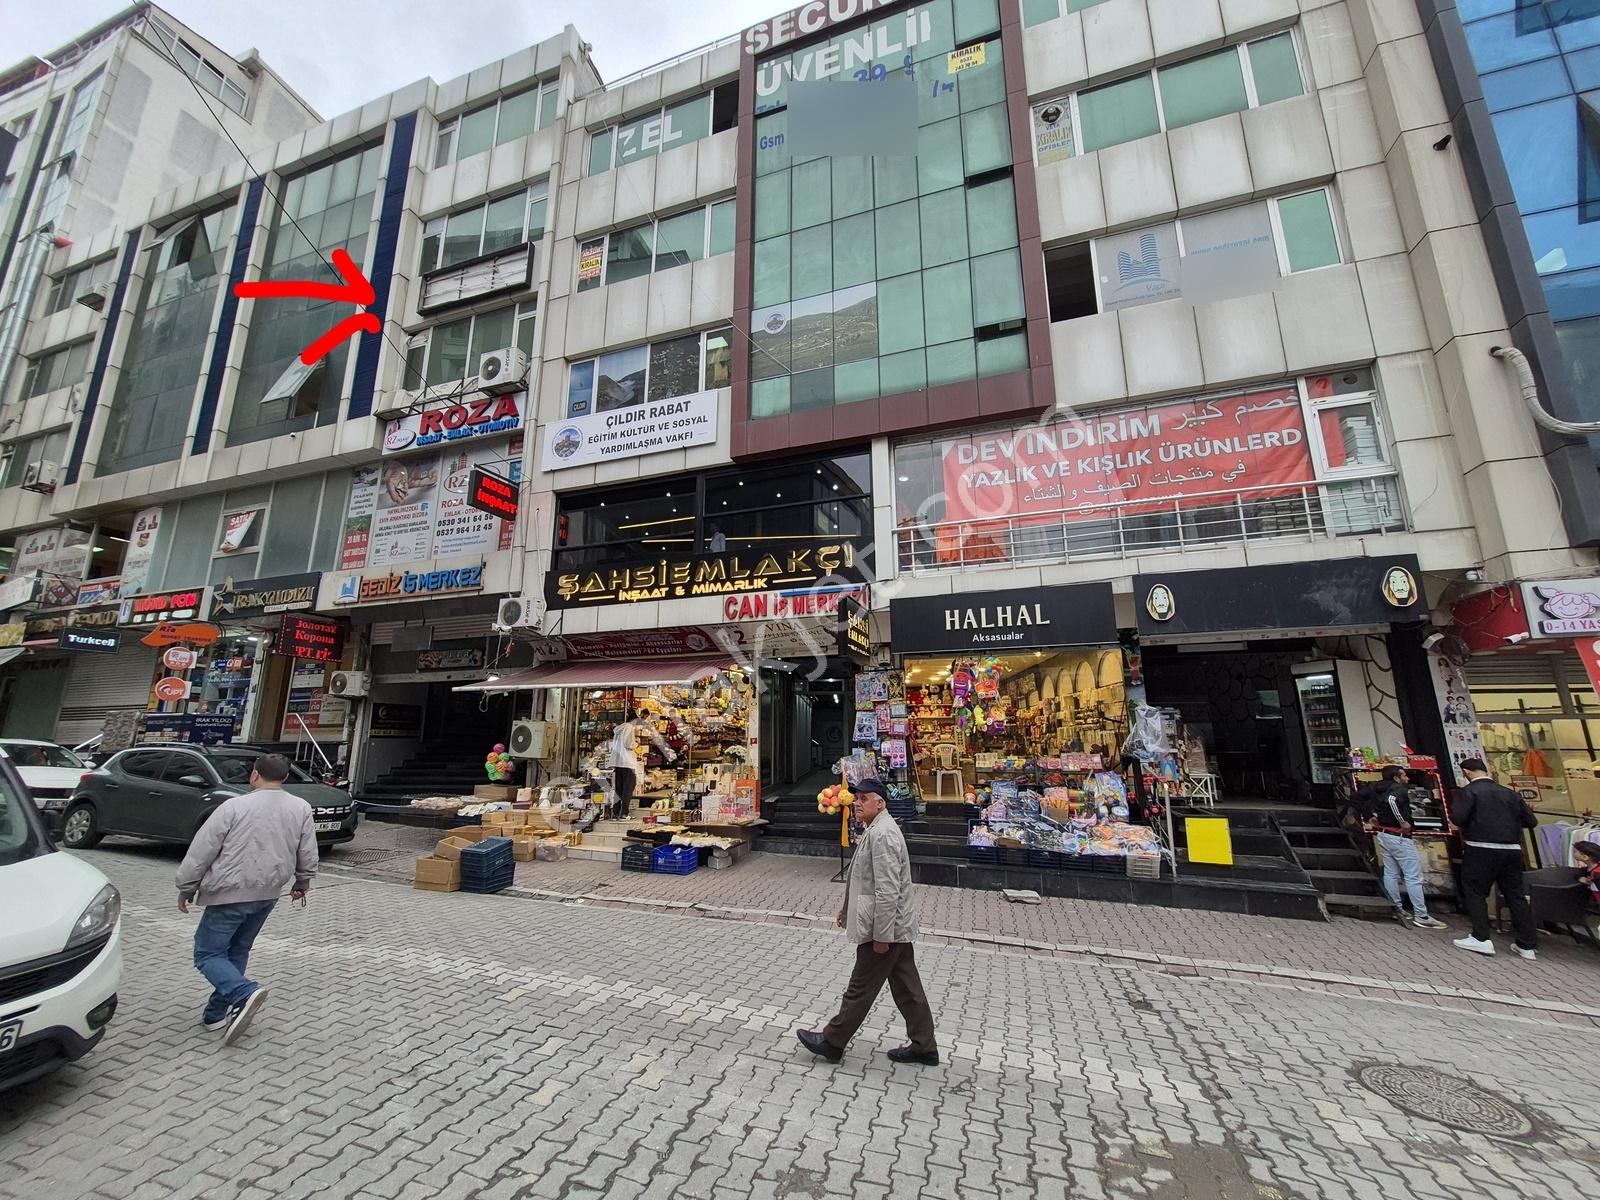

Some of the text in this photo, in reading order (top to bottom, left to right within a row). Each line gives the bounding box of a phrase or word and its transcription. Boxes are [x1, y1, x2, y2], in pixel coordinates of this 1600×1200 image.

[760, 133, 785, 150] Gsm
[419, 393, 520, 436] ROZA
[606, 401, 692, 428] ÇILDIR RABAT
[1171, 400, 1223, 430] كبير
[588, 415, 709, 444] EĞİTİM KÜLTÜR VE SOSYAL
[956, 413, 1160, 465] DEV İNDİRİM
[600, 431, 693, 455] YARDIMLAŞMA VAKFI
[962, 464, 1036, 489] YAZLIK
[1041, 461, 1071, 478] VE
[1077, 448, 1153, 475] KIŞLIK
[1221, 458, 1247, 483] في
[482, 476, 511, 498] ROZA
[441, 498, 464, 509] ROZA
[436, 527, 453, 537] 0537
[483, 523, 493, 531] 45
[618, 577, 768, 604] İNŞAAT & MİMARLIK
[725, 594, 768, 620] CAN
[945, 603, 1051, 630] HALHAL
[160, 625, 176, 633] Ria
[295, 630, 335, 645] Корона
[973, 631, 1025, 642] Aksasualar
[1546, 620, 1576, 631] 0-14
[68, 634, 116, 647] Turkcell
